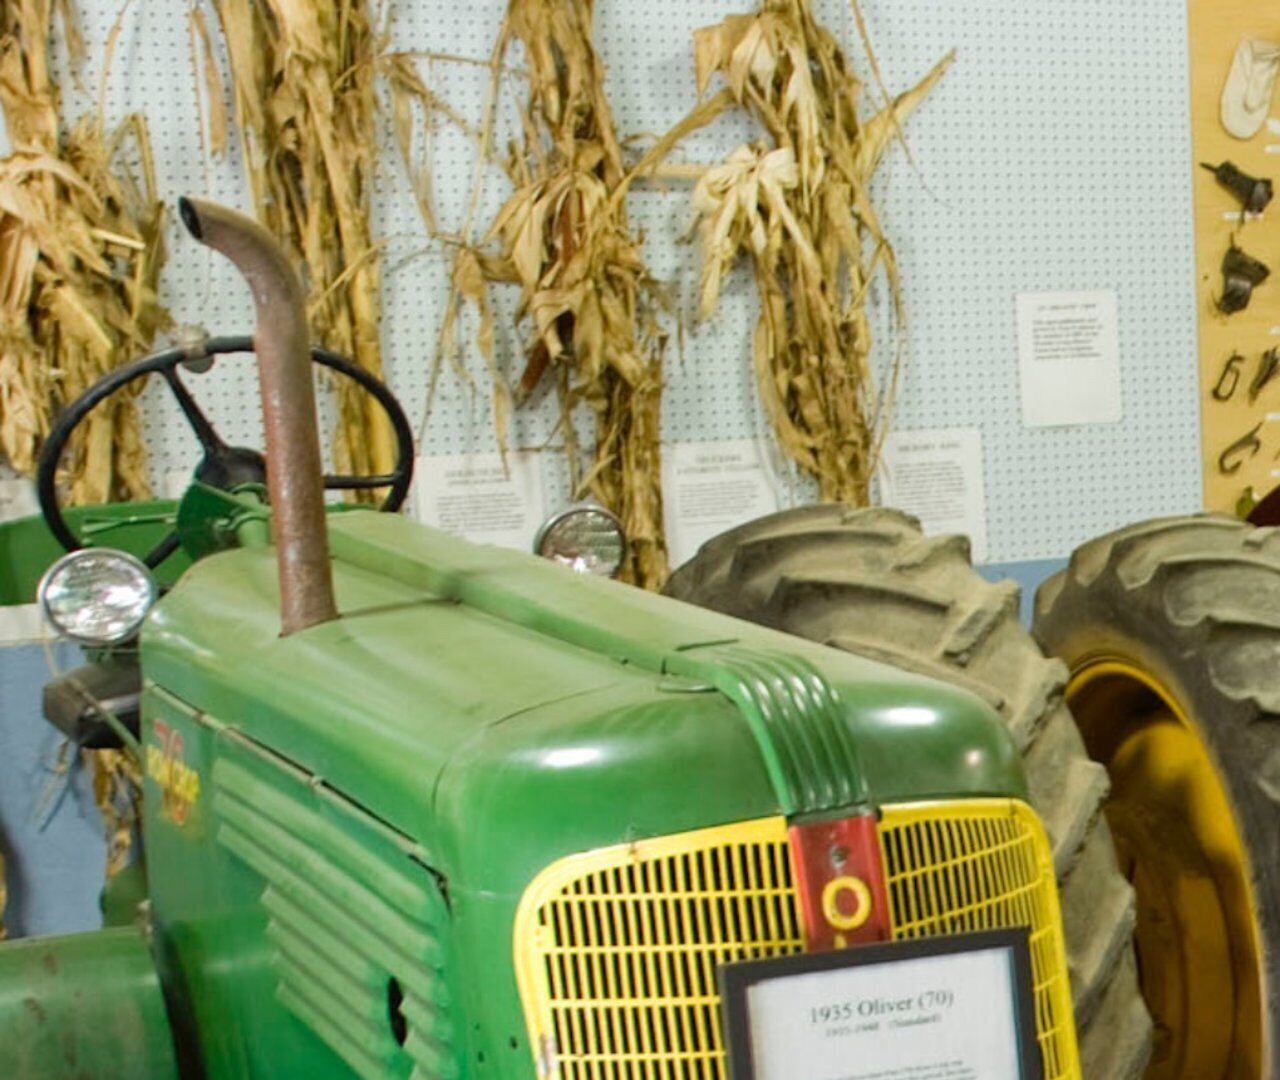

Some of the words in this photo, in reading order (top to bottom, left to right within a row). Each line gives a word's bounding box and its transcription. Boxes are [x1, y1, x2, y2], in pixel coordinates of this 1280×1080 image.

[810, 1003, 852, 1024] 1935
[857, 995, 914, 1017] Oliver
[918, 988, 955, 1010] (70)
